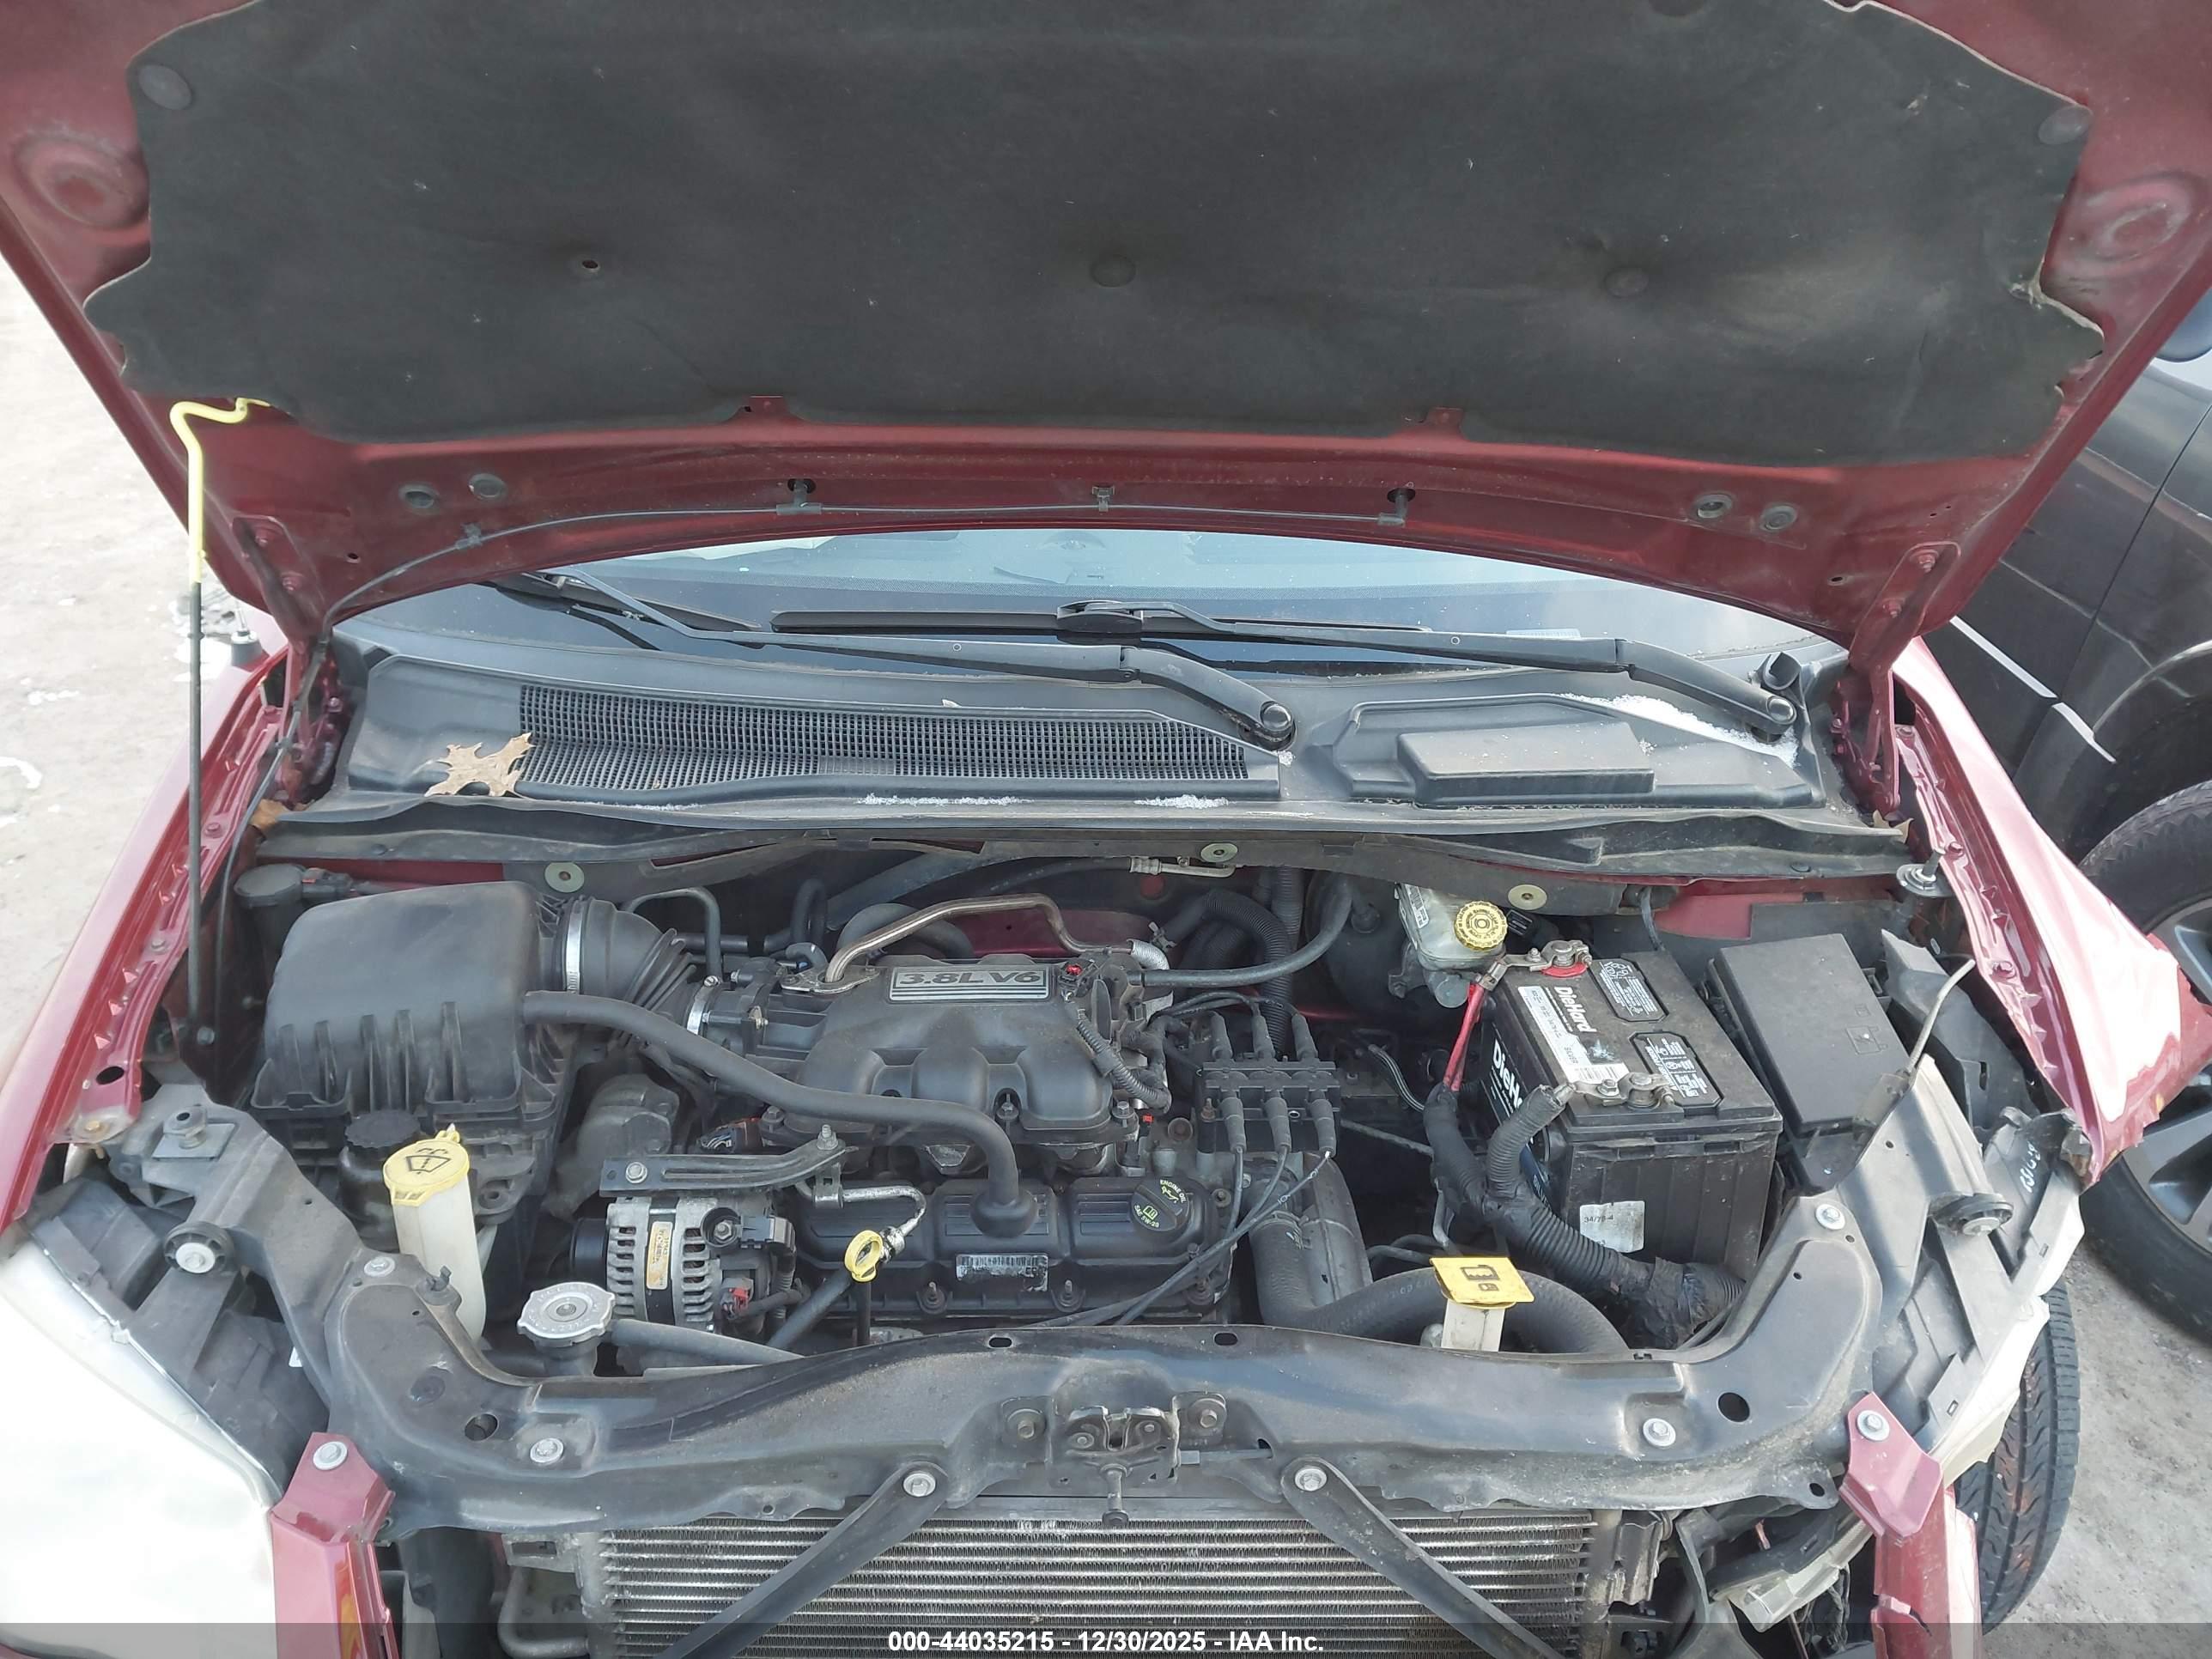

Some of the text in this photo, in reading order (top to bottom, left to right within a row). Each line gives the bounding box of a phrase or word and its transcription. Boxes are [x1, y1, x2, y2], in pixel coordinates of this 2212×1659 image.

[900, 971, 1041, 984] 3.8L V6
[1553, 986, 1598, 1032] DieHard
[1159, 1179, 1187, 1203] ENGINE OIL
[1134, 1205, 1160, 1228] SAE 5W-20
